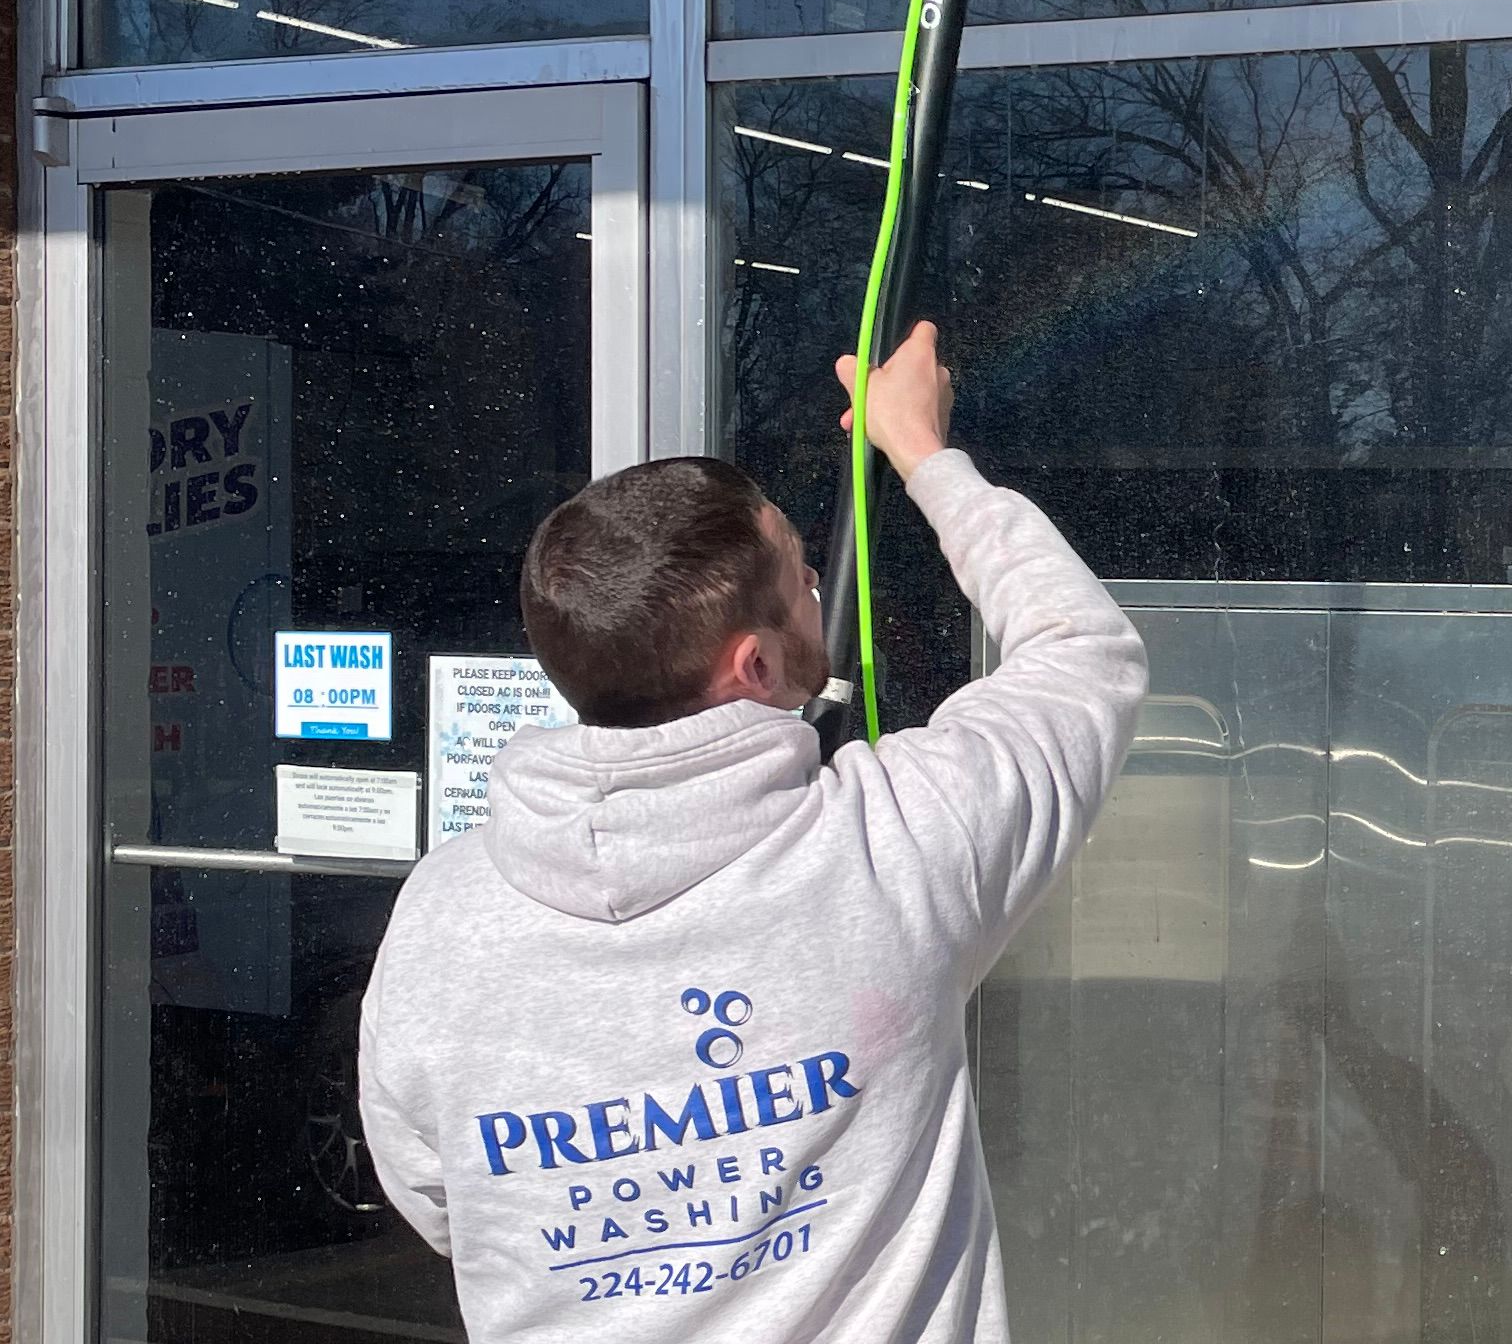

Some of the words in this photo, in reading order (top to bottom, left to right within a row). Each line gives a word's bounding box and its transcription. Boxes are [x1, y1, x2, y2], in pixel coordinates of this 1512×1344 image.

[147, 464, 258, 536] IES
[284, 644, 326, 668] LAST
[329, 645, 383, 669] WASH
[453, 668, 489, 679] PLEASE
[492, 669, 516, 680] KEEP
[457, 685, 494, 696] CLOSED
[497, 687, 511, 697] AC
[513, 688, 522, 697] IS
[457, 702, 466, 712] IF
[468, 703, 501, 714] DOORS
[503, 704, 523, 715] ARE
[525, 705, 549, 716] LEFT
[489, 721, 515, 732] OPEN
[473, 737, 496, 748] WILL
[469, 771, 489, 782] LAS
[442, 821, 461, 832] LAS
[475, 1050, 861, 1176] PREMIER
[568, 1147, 787, 1211] POWER
[540, 1165, 825, 1253] WASHING
[579, 1222, 812, 1302] 224-242-6701
